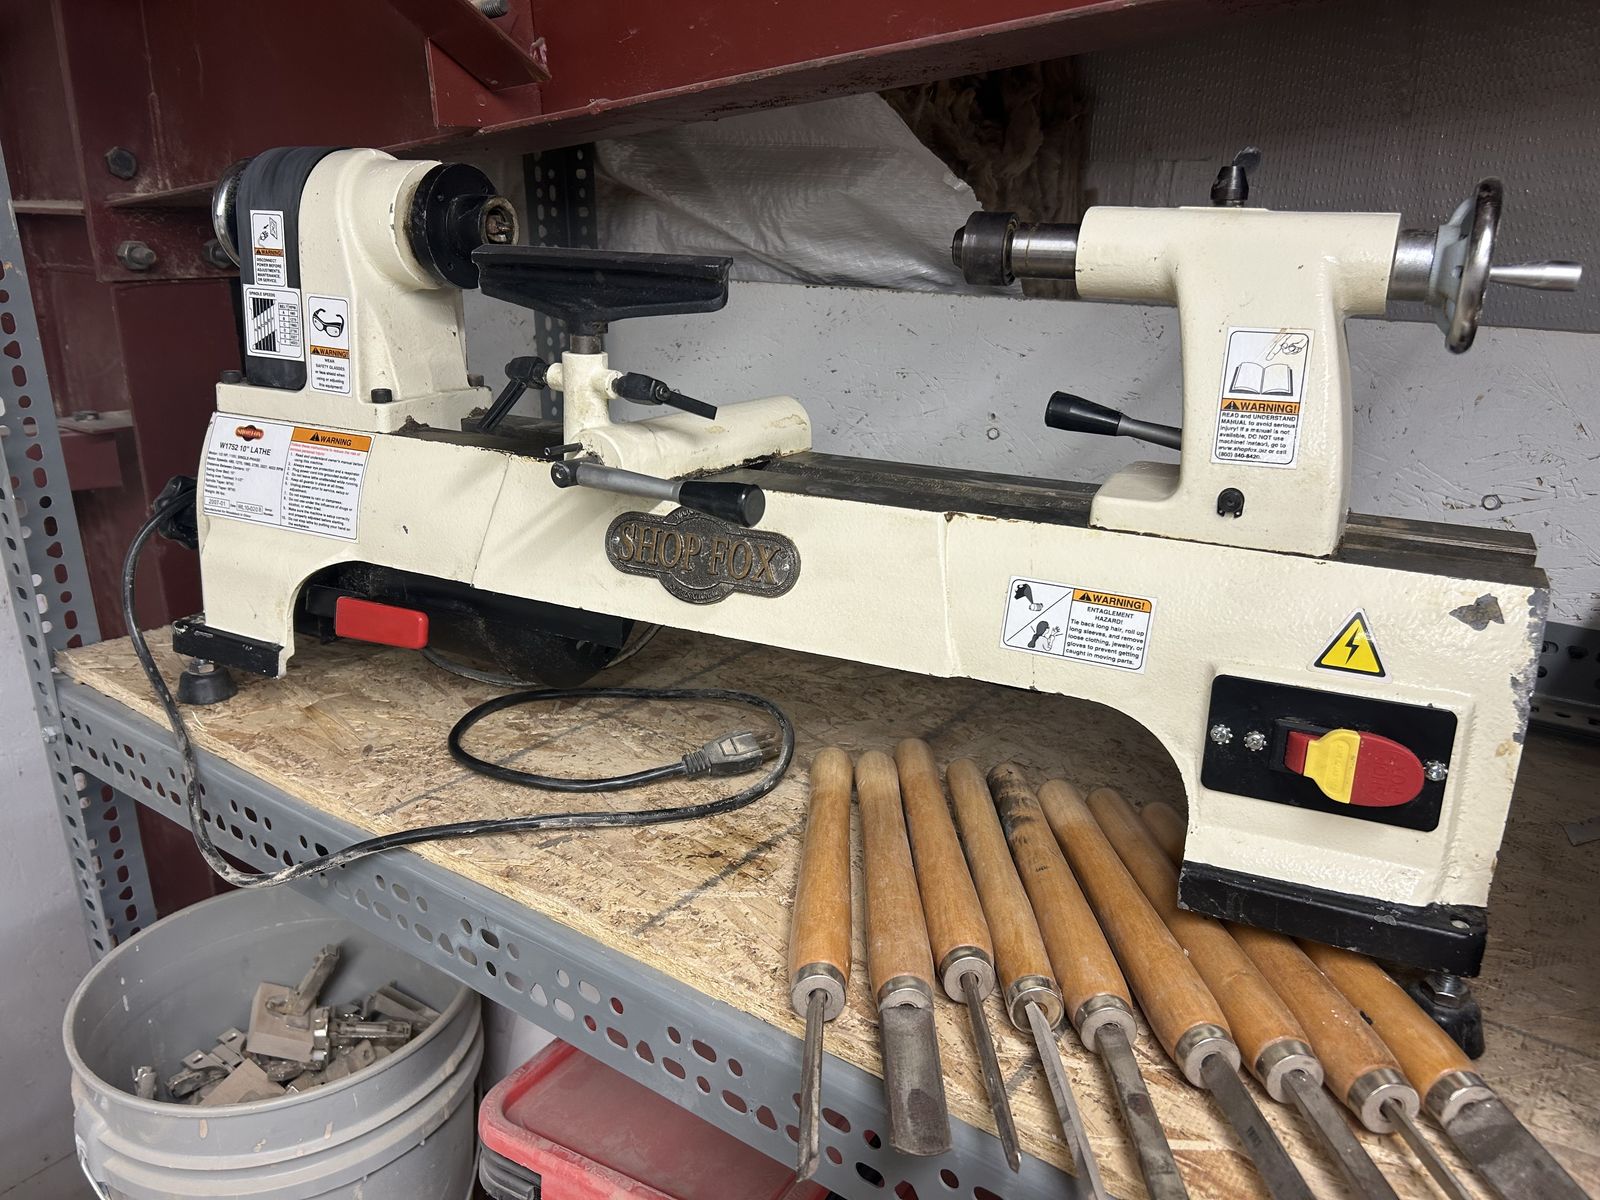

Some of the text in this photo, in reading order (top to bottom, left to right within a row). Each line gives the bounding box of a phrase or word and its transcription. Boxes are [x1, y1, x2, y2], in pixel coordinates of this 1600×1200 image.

[1240, 402, 1296, 413] WARNING!
[320, 436, 352, 446] WARNING
[220, 442, 238, 450] W1752
[250, 447, 271, 455] LATHE
[618, 523, 782, 586] SHOP FOX
[1093, 594, 1145, 610] WARNING!
[1087, 607, 1134, 619] ENTAGLEMENT
[1095, 616, 1124, 625] HAZARD!
[1069, 626, 1082, 634] long
[1084, 629, 1107, 638] sleeves,
[1096, 622, 1109, 631] long
[1111, 624, 1124, 633] hair,
[1085, 636, 1110, 646] clothing,
[1112, 641, 1135, 651] jewelry,
[1094, 653, 1116, 662] moving
[1095, 646, 1117, 654] prevent
[1118, 650, 1139, 659] getting
